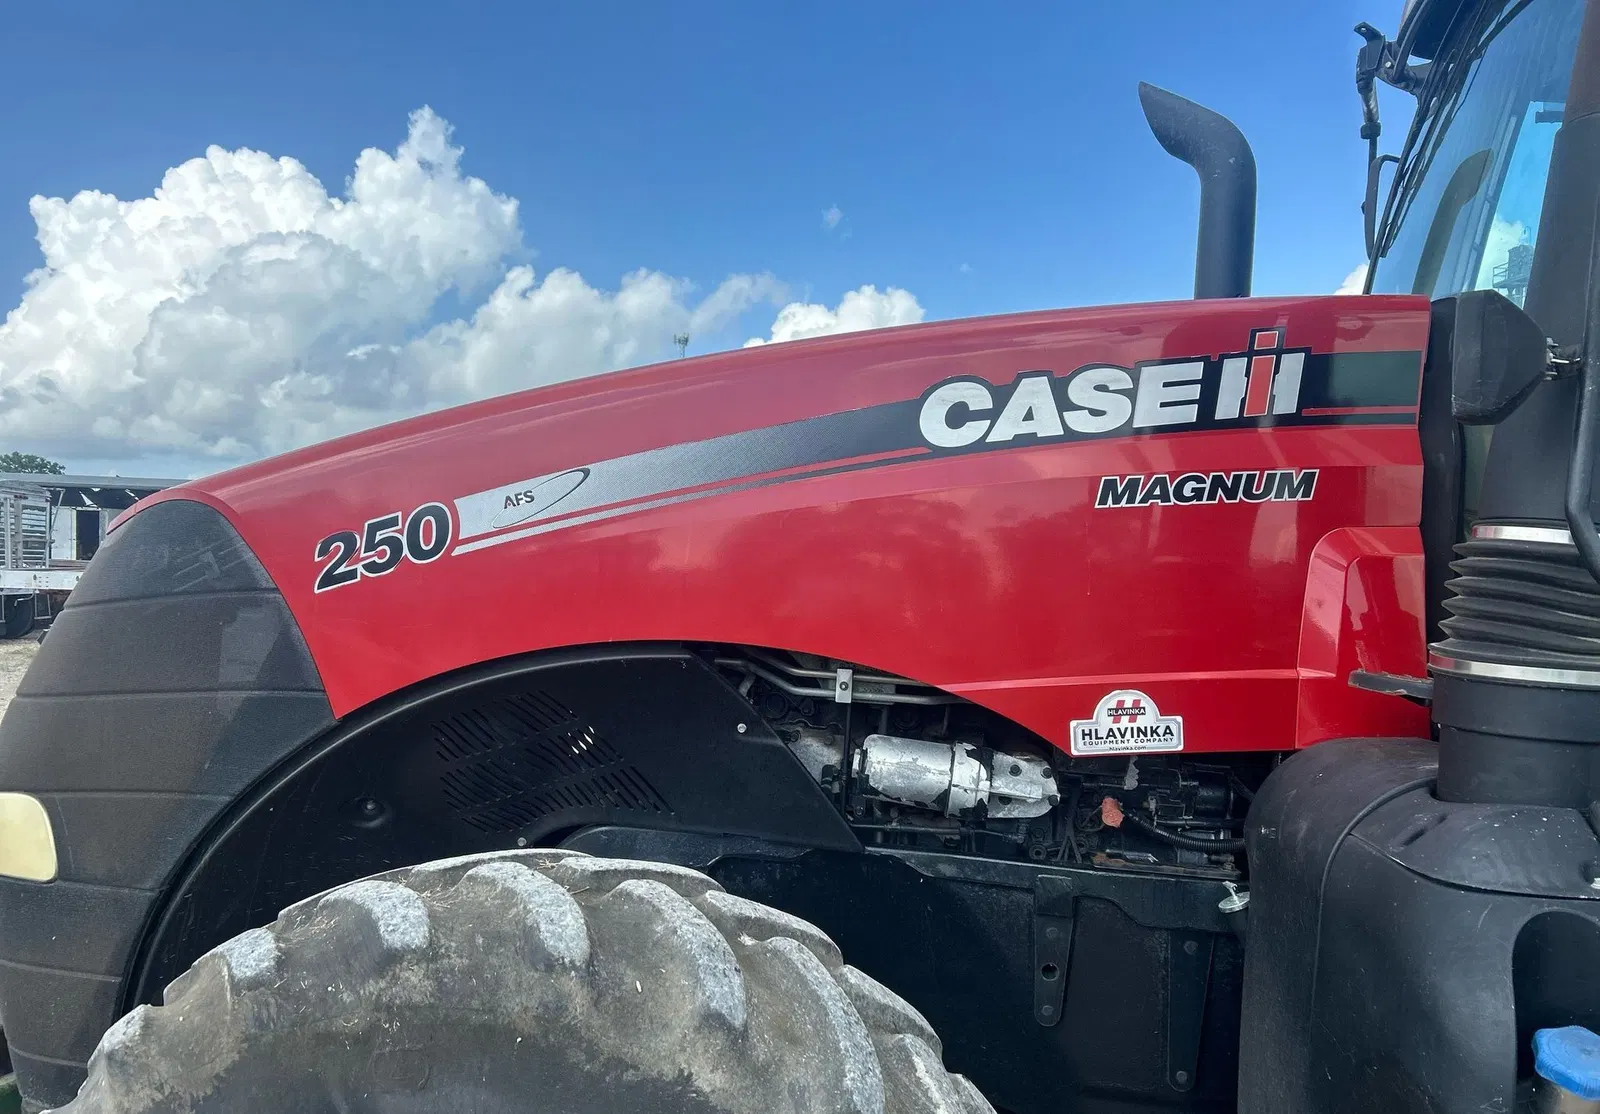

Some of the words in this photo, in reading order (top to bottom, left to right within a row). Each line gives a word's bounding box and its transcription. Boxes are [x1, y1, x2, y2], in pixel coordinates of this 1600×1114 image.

[918, 361, 1205, 448] CASE
[503, 489, 535, 509] AFS
[1094, 469, 1320, 508] MAGNUM
[314, 501, 452, 593] 250
[1107, 707, 1146, 717] HLAVINKA
[1081, 725, 1175, 741] HLAVINKA
